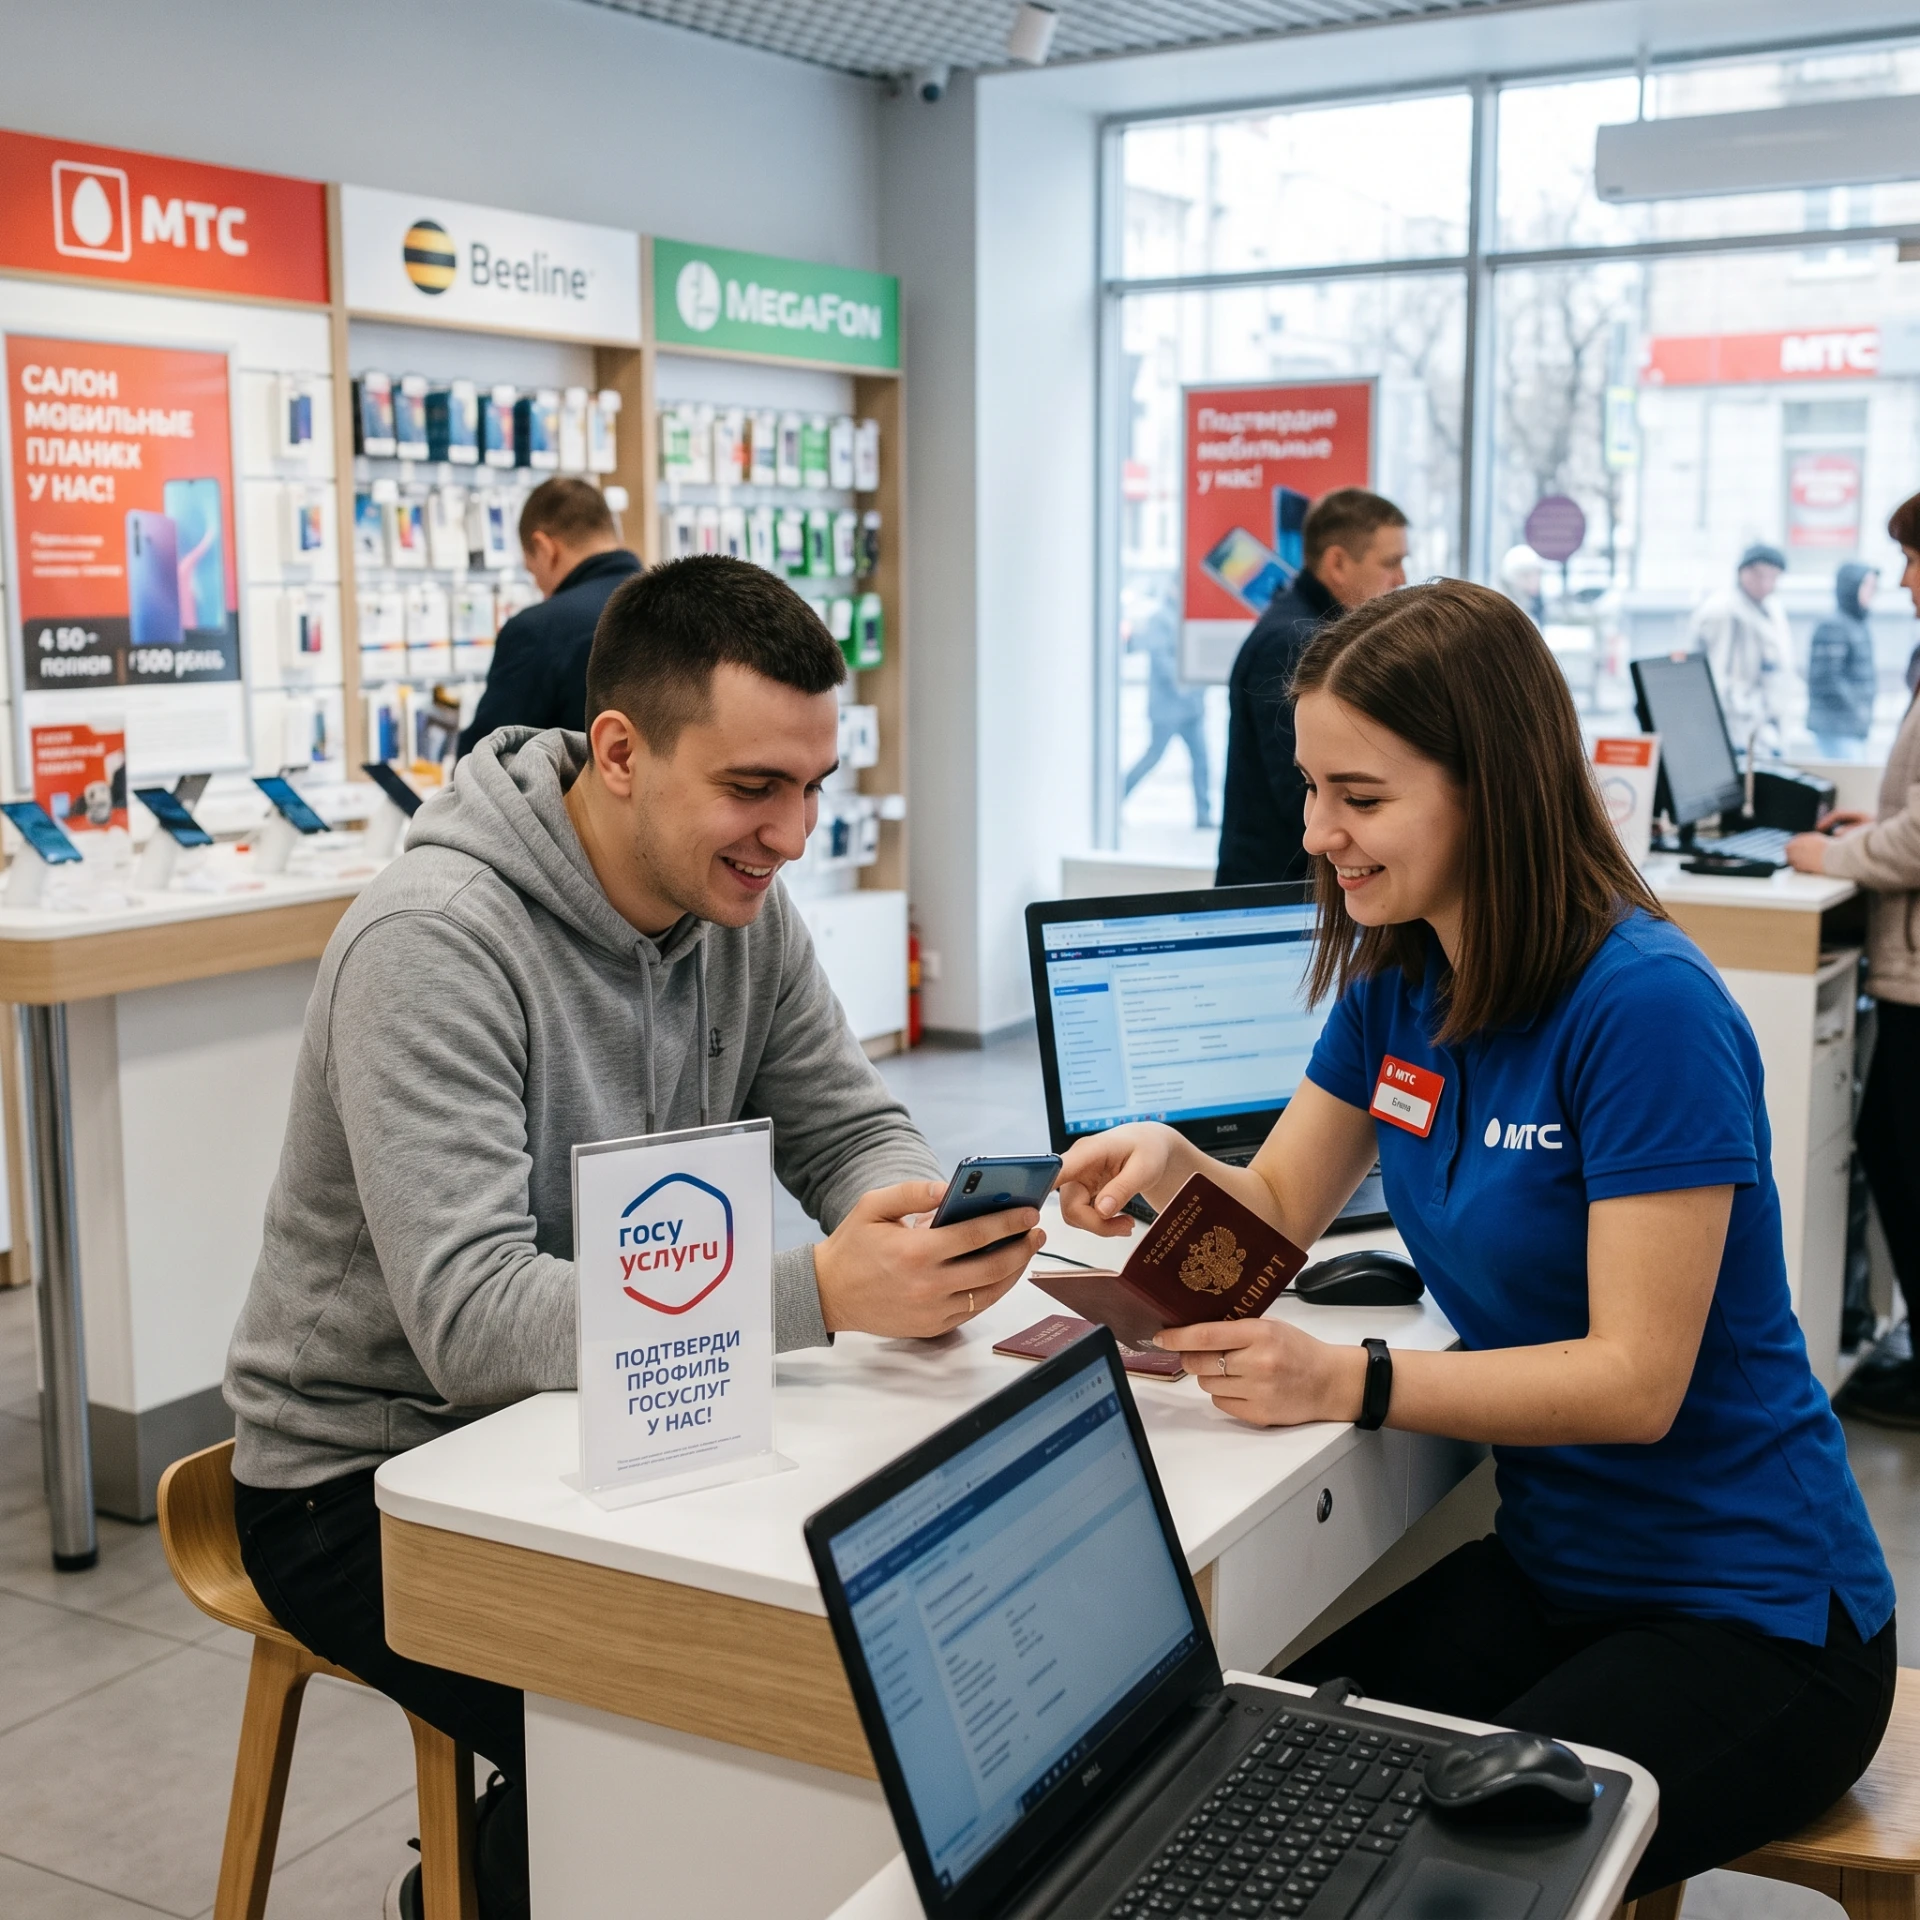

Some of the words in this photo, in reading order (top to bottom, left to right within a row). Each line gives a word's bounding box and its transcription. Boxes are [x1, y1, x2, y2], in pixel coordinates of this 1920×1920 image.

[142, 195, 248, 256] МТС
[470, 241, 587, 300] Beeline
[1780, 333, 1878, 373] МТС
[21, 364, 118, 399] САЛОН
[24, 400, 194, 438] МОБИЛЬНЫЕ
[27, 473, 47, 502] У
[51, 473, 115, 503] НАС!
[1395, 1068, 1417, 1085] МТС
[1503, 1123, 1563, 1150] МТС
[616, 1330, 740, 1370] ПОДТВЕРДИ
[628, 1357, 730, 1391] ПРОФИЛЬ
[629, 1379, 731, 1415] ГОСУСЛУГ
[647, 1418, 659, 1436] У
[666, 1407, 711, 1432] НАС!
